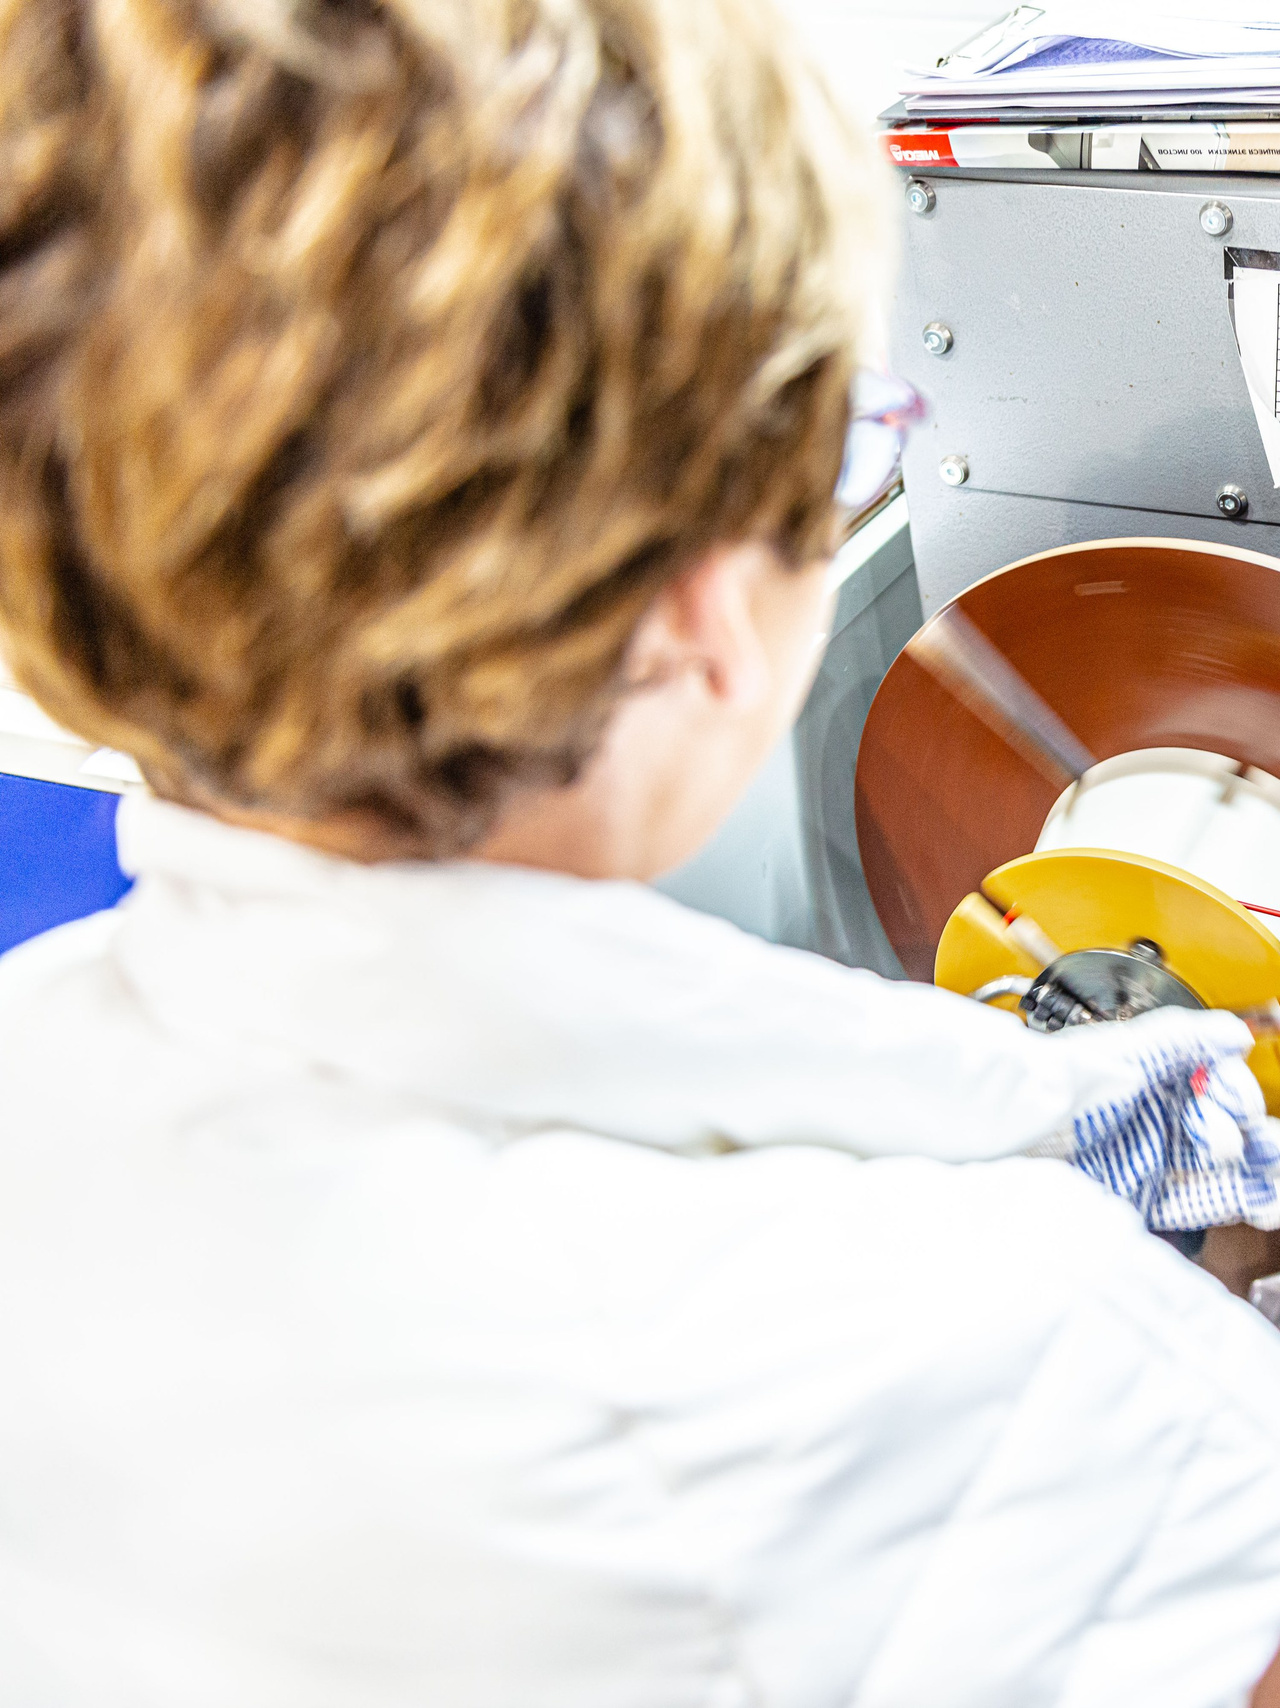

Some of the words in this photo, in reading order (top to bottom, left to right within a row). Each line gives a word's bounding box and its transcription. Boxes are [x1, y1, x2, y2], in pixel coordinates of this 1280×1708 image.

[891, 149, 941, 162] MEGA
[1157, 148, 1189, 156] ЛИСТОВ
[1189, 148, 1203, 156] 100
[1207, 148, 1247, 156] ЭТИКЕТКИ
